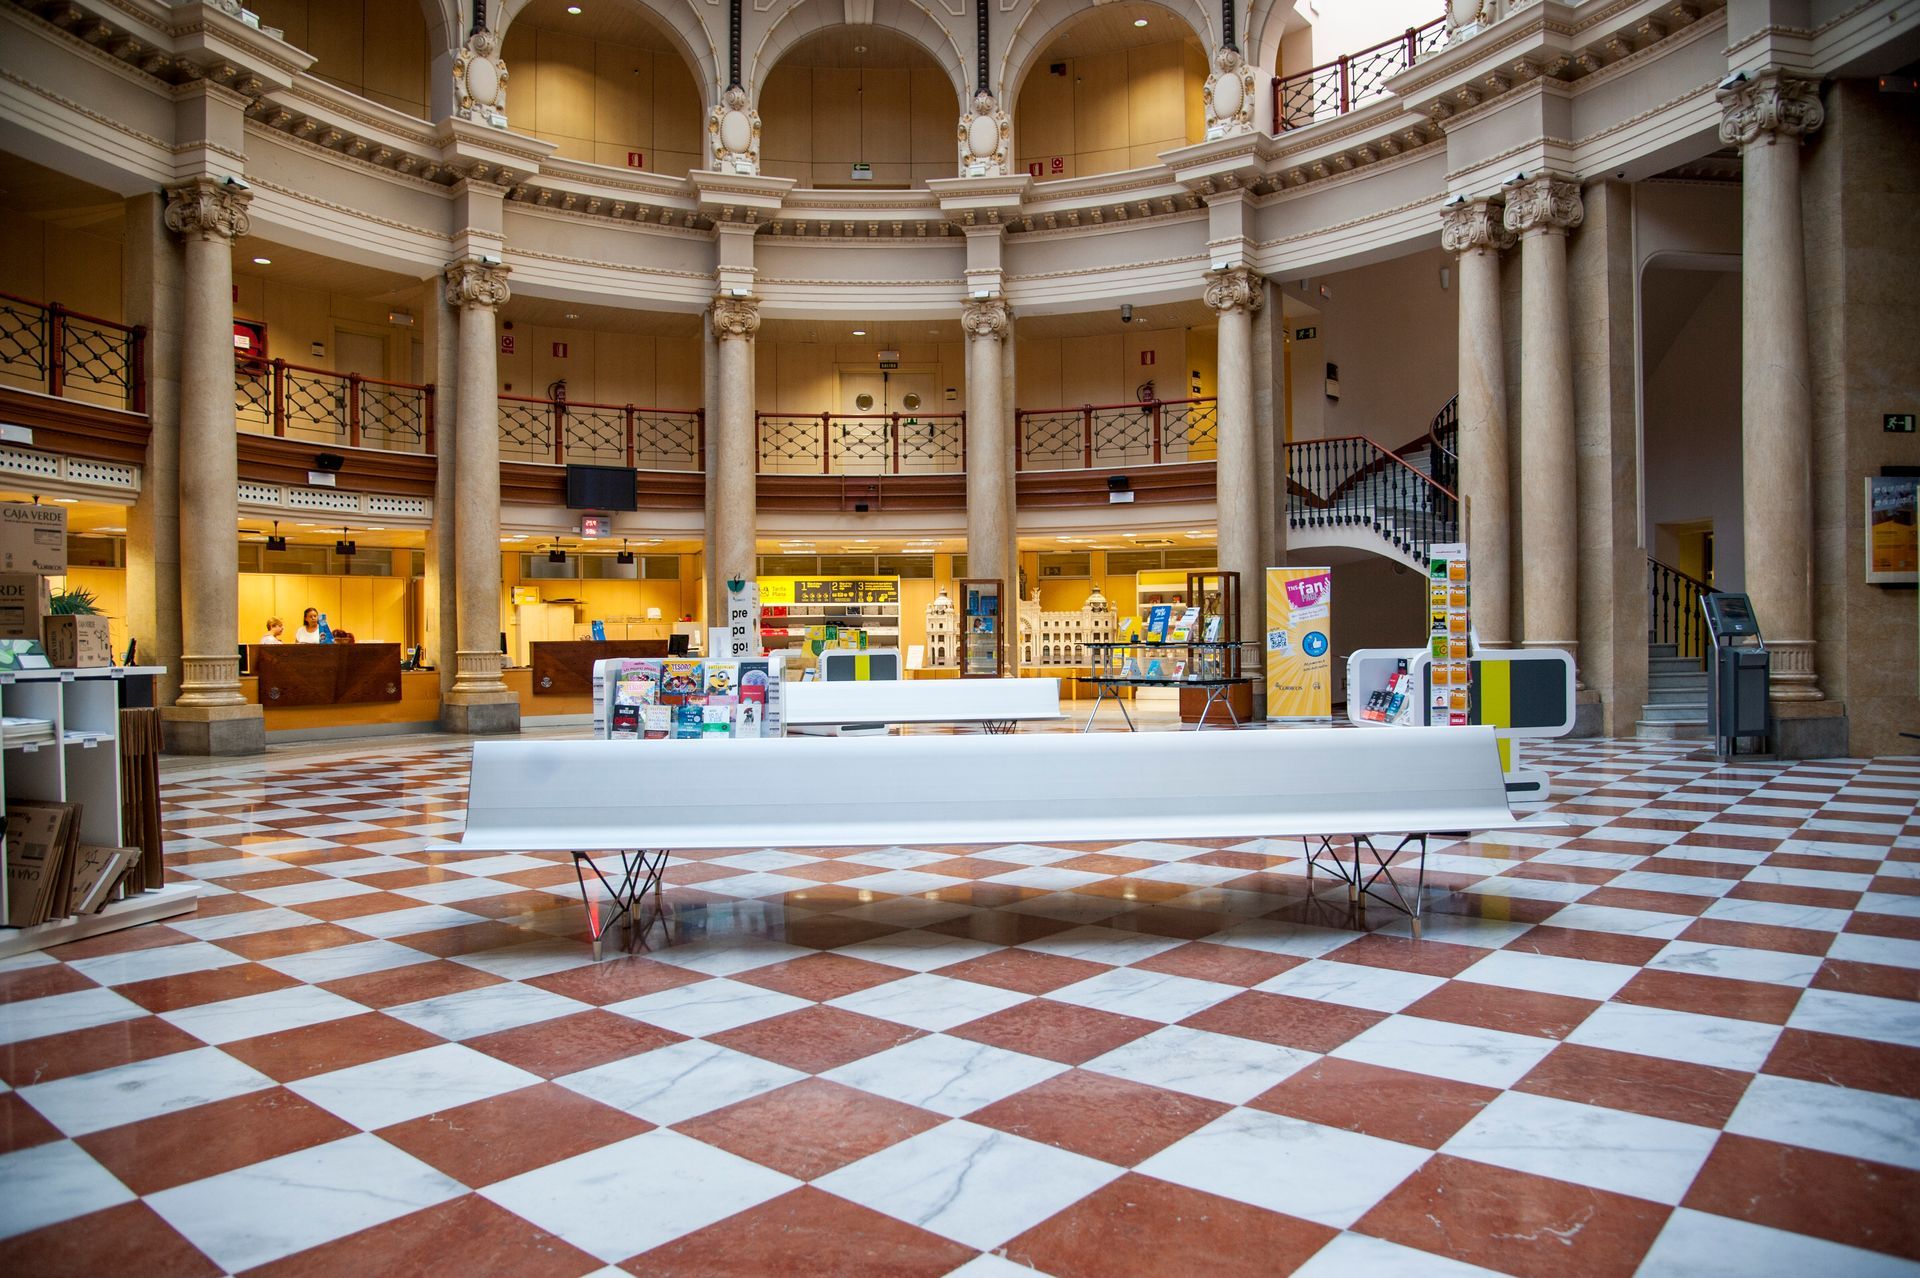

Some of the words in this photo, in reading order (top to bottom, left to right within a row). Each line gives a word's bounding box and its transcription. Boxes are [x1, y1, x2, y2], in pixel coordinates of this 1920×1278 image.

[3, 508, 29, 520] CAJA
[31, 510, 63, 522] VERDE
[801, 582, 807, 590] 1
[832, 582, 838, 590] 2
[858, 582, 864, 590] 3
[1299, 581, 1323, 598] fan
[732, 609, 748, 620] pre
[732, 626, 745, 637] pa
[732, 642, 749, 654] go!
[672, 663, 691, 672] TESORO
